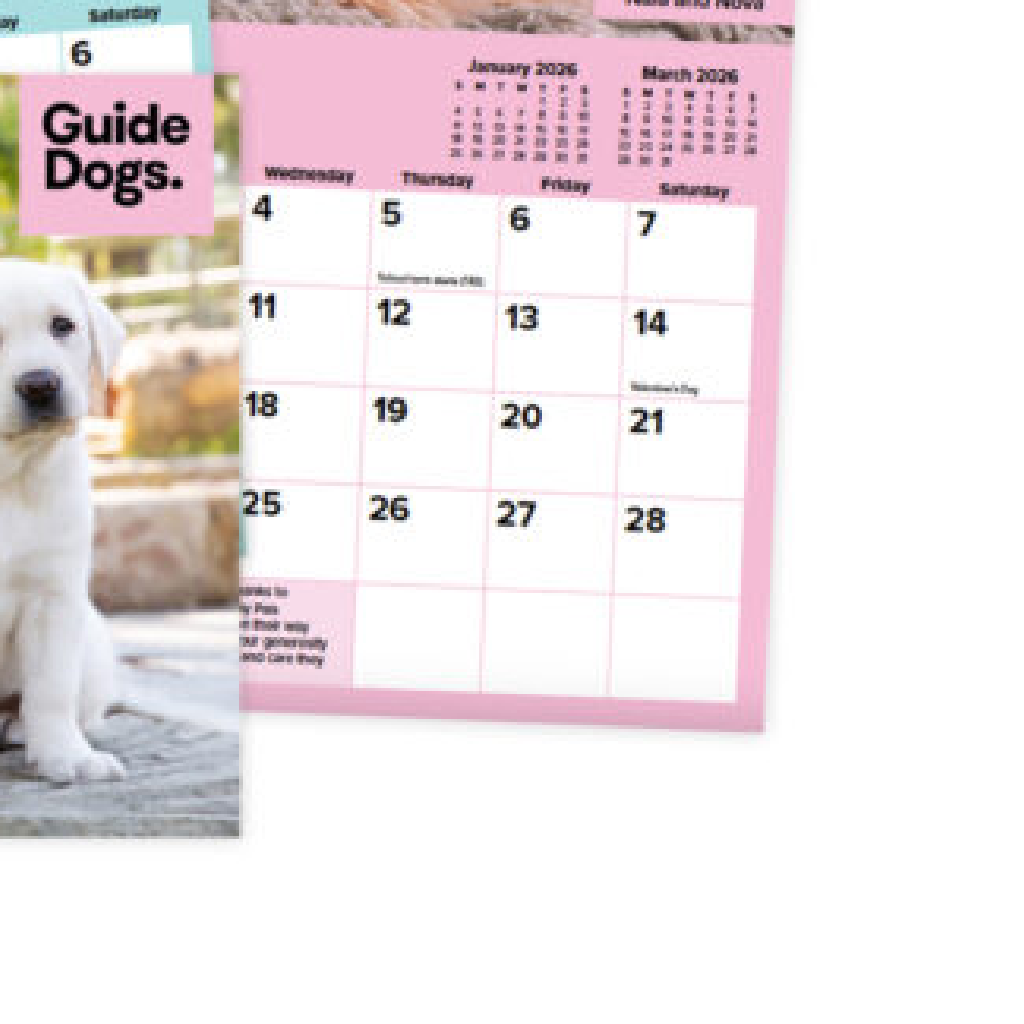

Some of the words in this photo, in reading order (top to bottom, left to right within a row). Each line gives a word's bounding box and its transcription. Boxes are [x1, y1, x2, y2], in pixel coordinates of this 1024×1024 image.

[88, 6, 161, 22] Saturday
[72, 41, 91, 66] 6
[467, 56, 530, 78] January
[643, 66, 691, 82] March
[41, 101, 189, 145] Guide
[44, 148, 183, 208] Dogs.
[265, 167, 356, 186] Wednesday
[400, 170, 473, 189] Thursday
[542, 176, 590, 195] Friday
[659, 183, 729, 202] Saturday
[252, 195, 274, 221] 4
[381, 198, 400, 227] 5
[511, 205, 530, 233] 6
[637, 211, 656, 236] 7
[249, 293, 274, 318] 11
[378, 299, 410, 325] 12
[505, 303, 539, 331] 13
[634, 309, 669, 334] 14
[244, 391, 277, 416] 18
[372, 397, 407, 422] 19
[501, 404, 542, 429] 20
[631, 407, 662, 435] 21
[243, 489, 280, 517] 25
[369, 495, 410, 520] 26
[498, 501, 536, 527] 27
[624, 505, 665, 533] 28
